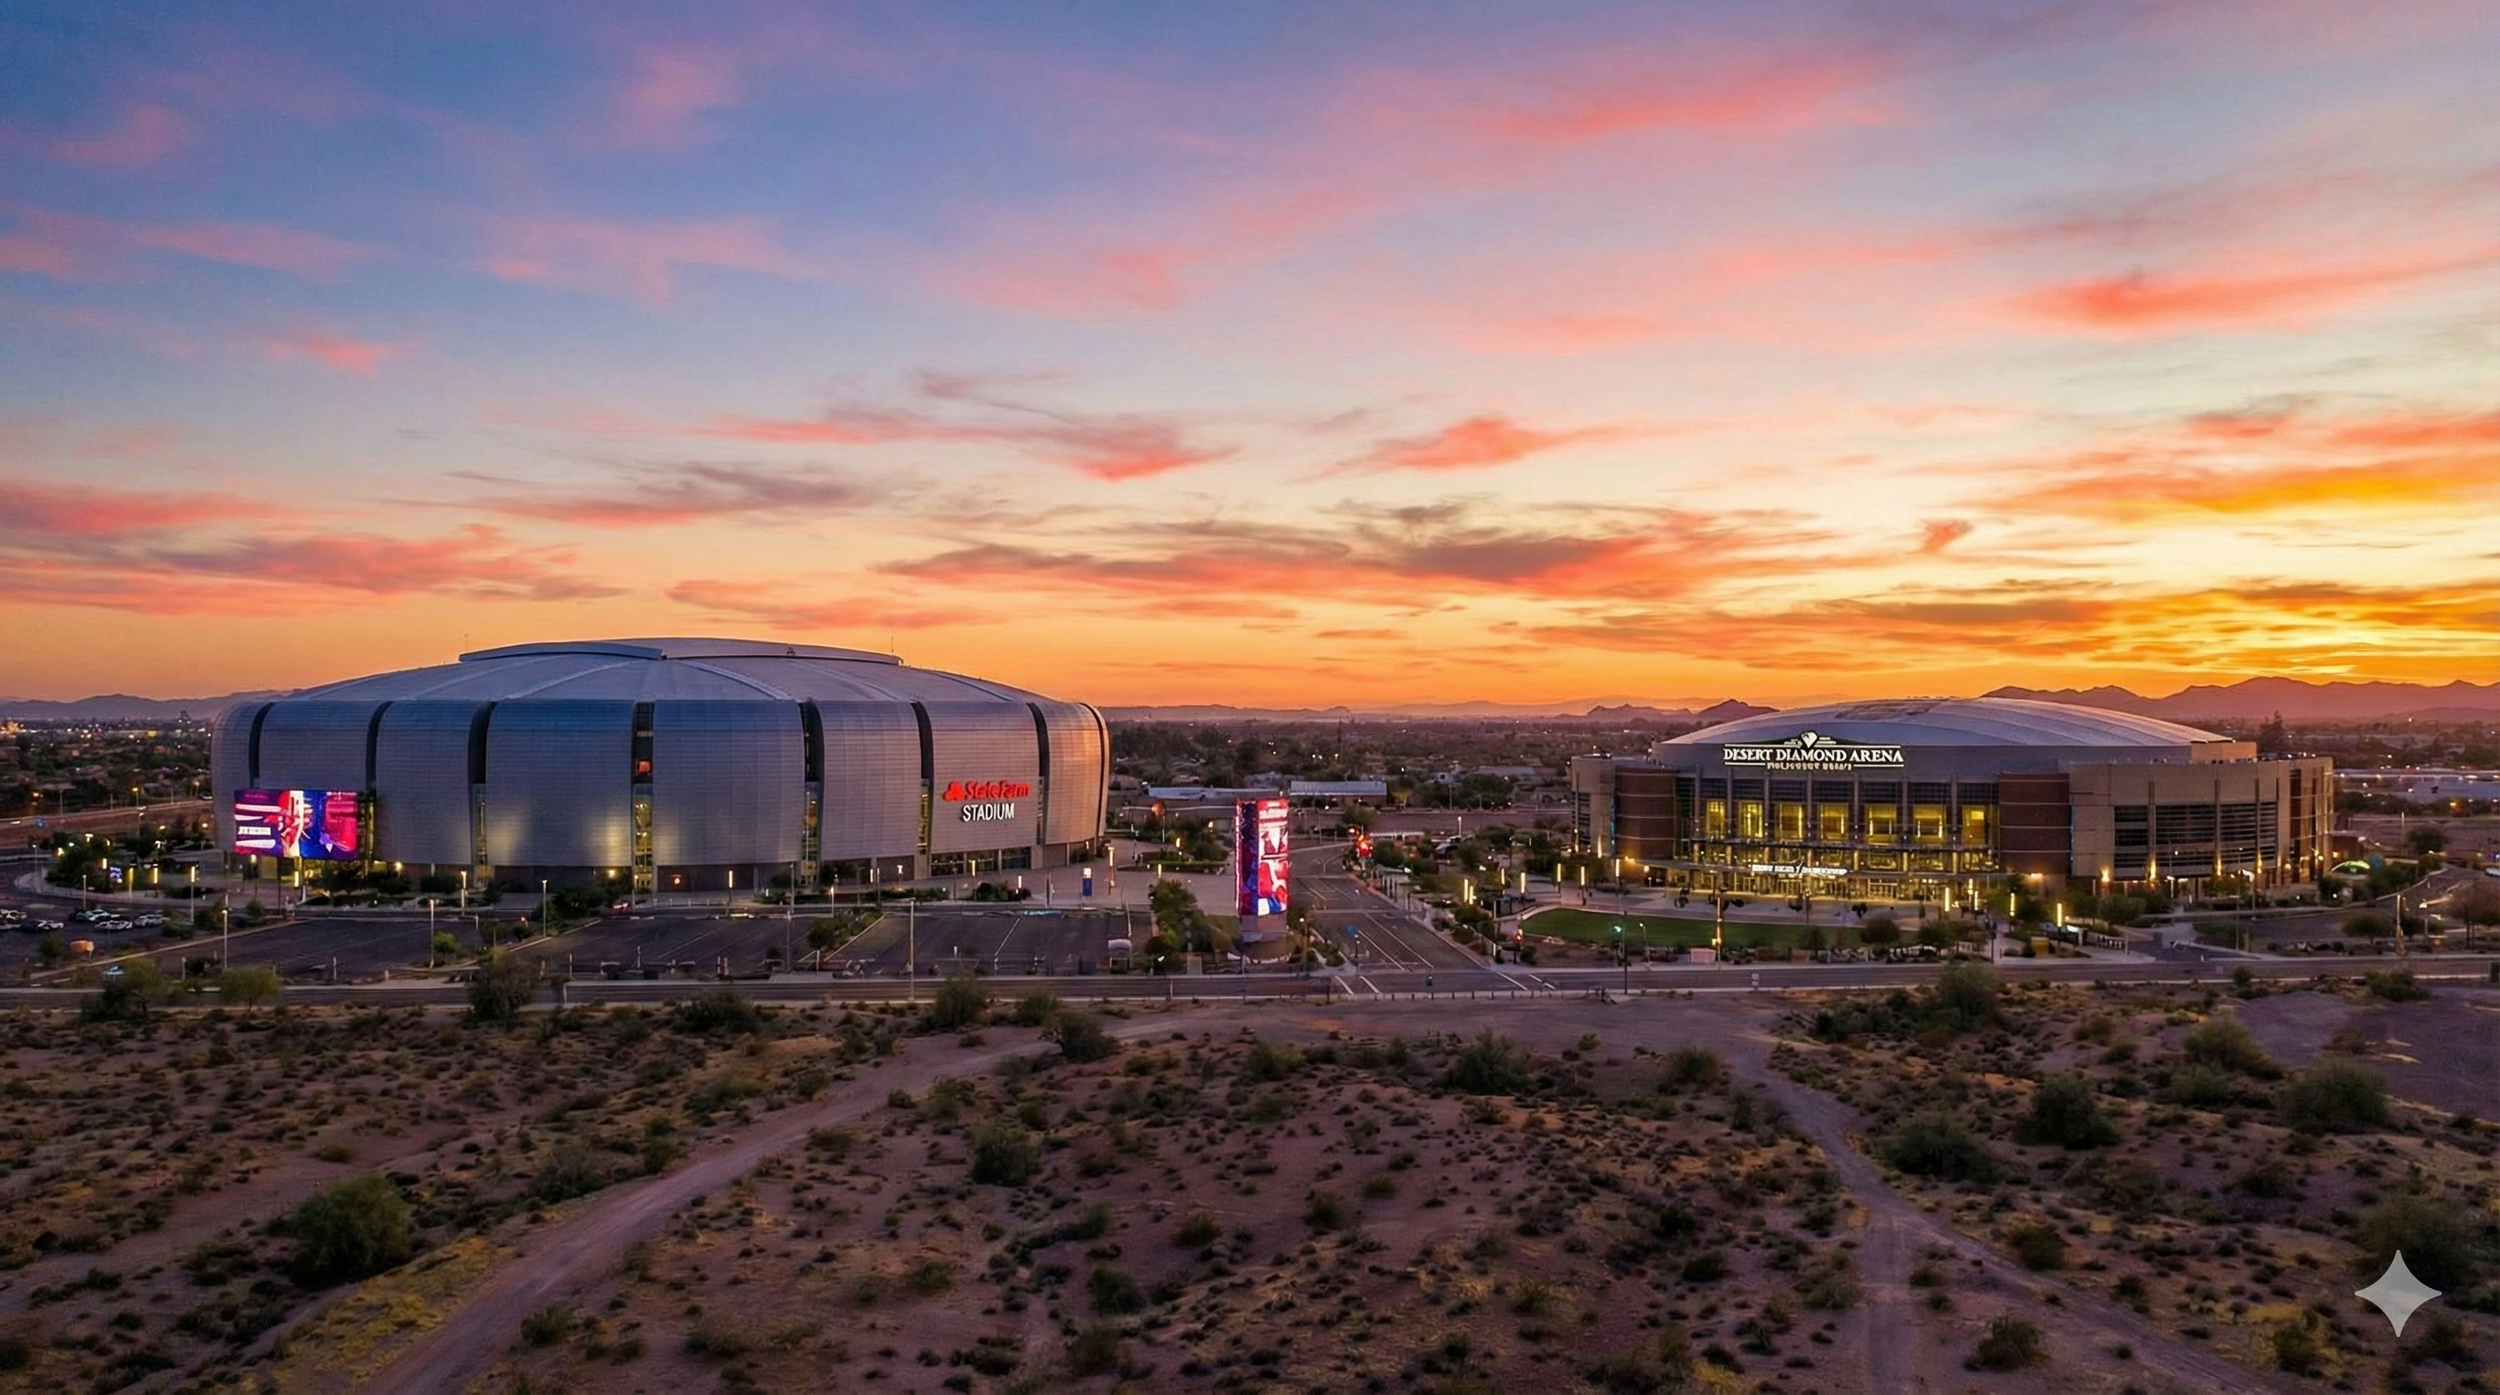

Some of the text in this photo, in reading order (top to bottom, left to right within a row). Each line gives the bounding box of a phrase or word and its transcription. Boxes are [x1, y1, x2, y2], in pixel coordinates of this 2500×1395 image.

[1723, 748, 1904, 763] DESERT DIAMOND ARENA
[962, 802, 1015, 822] STADIUM
